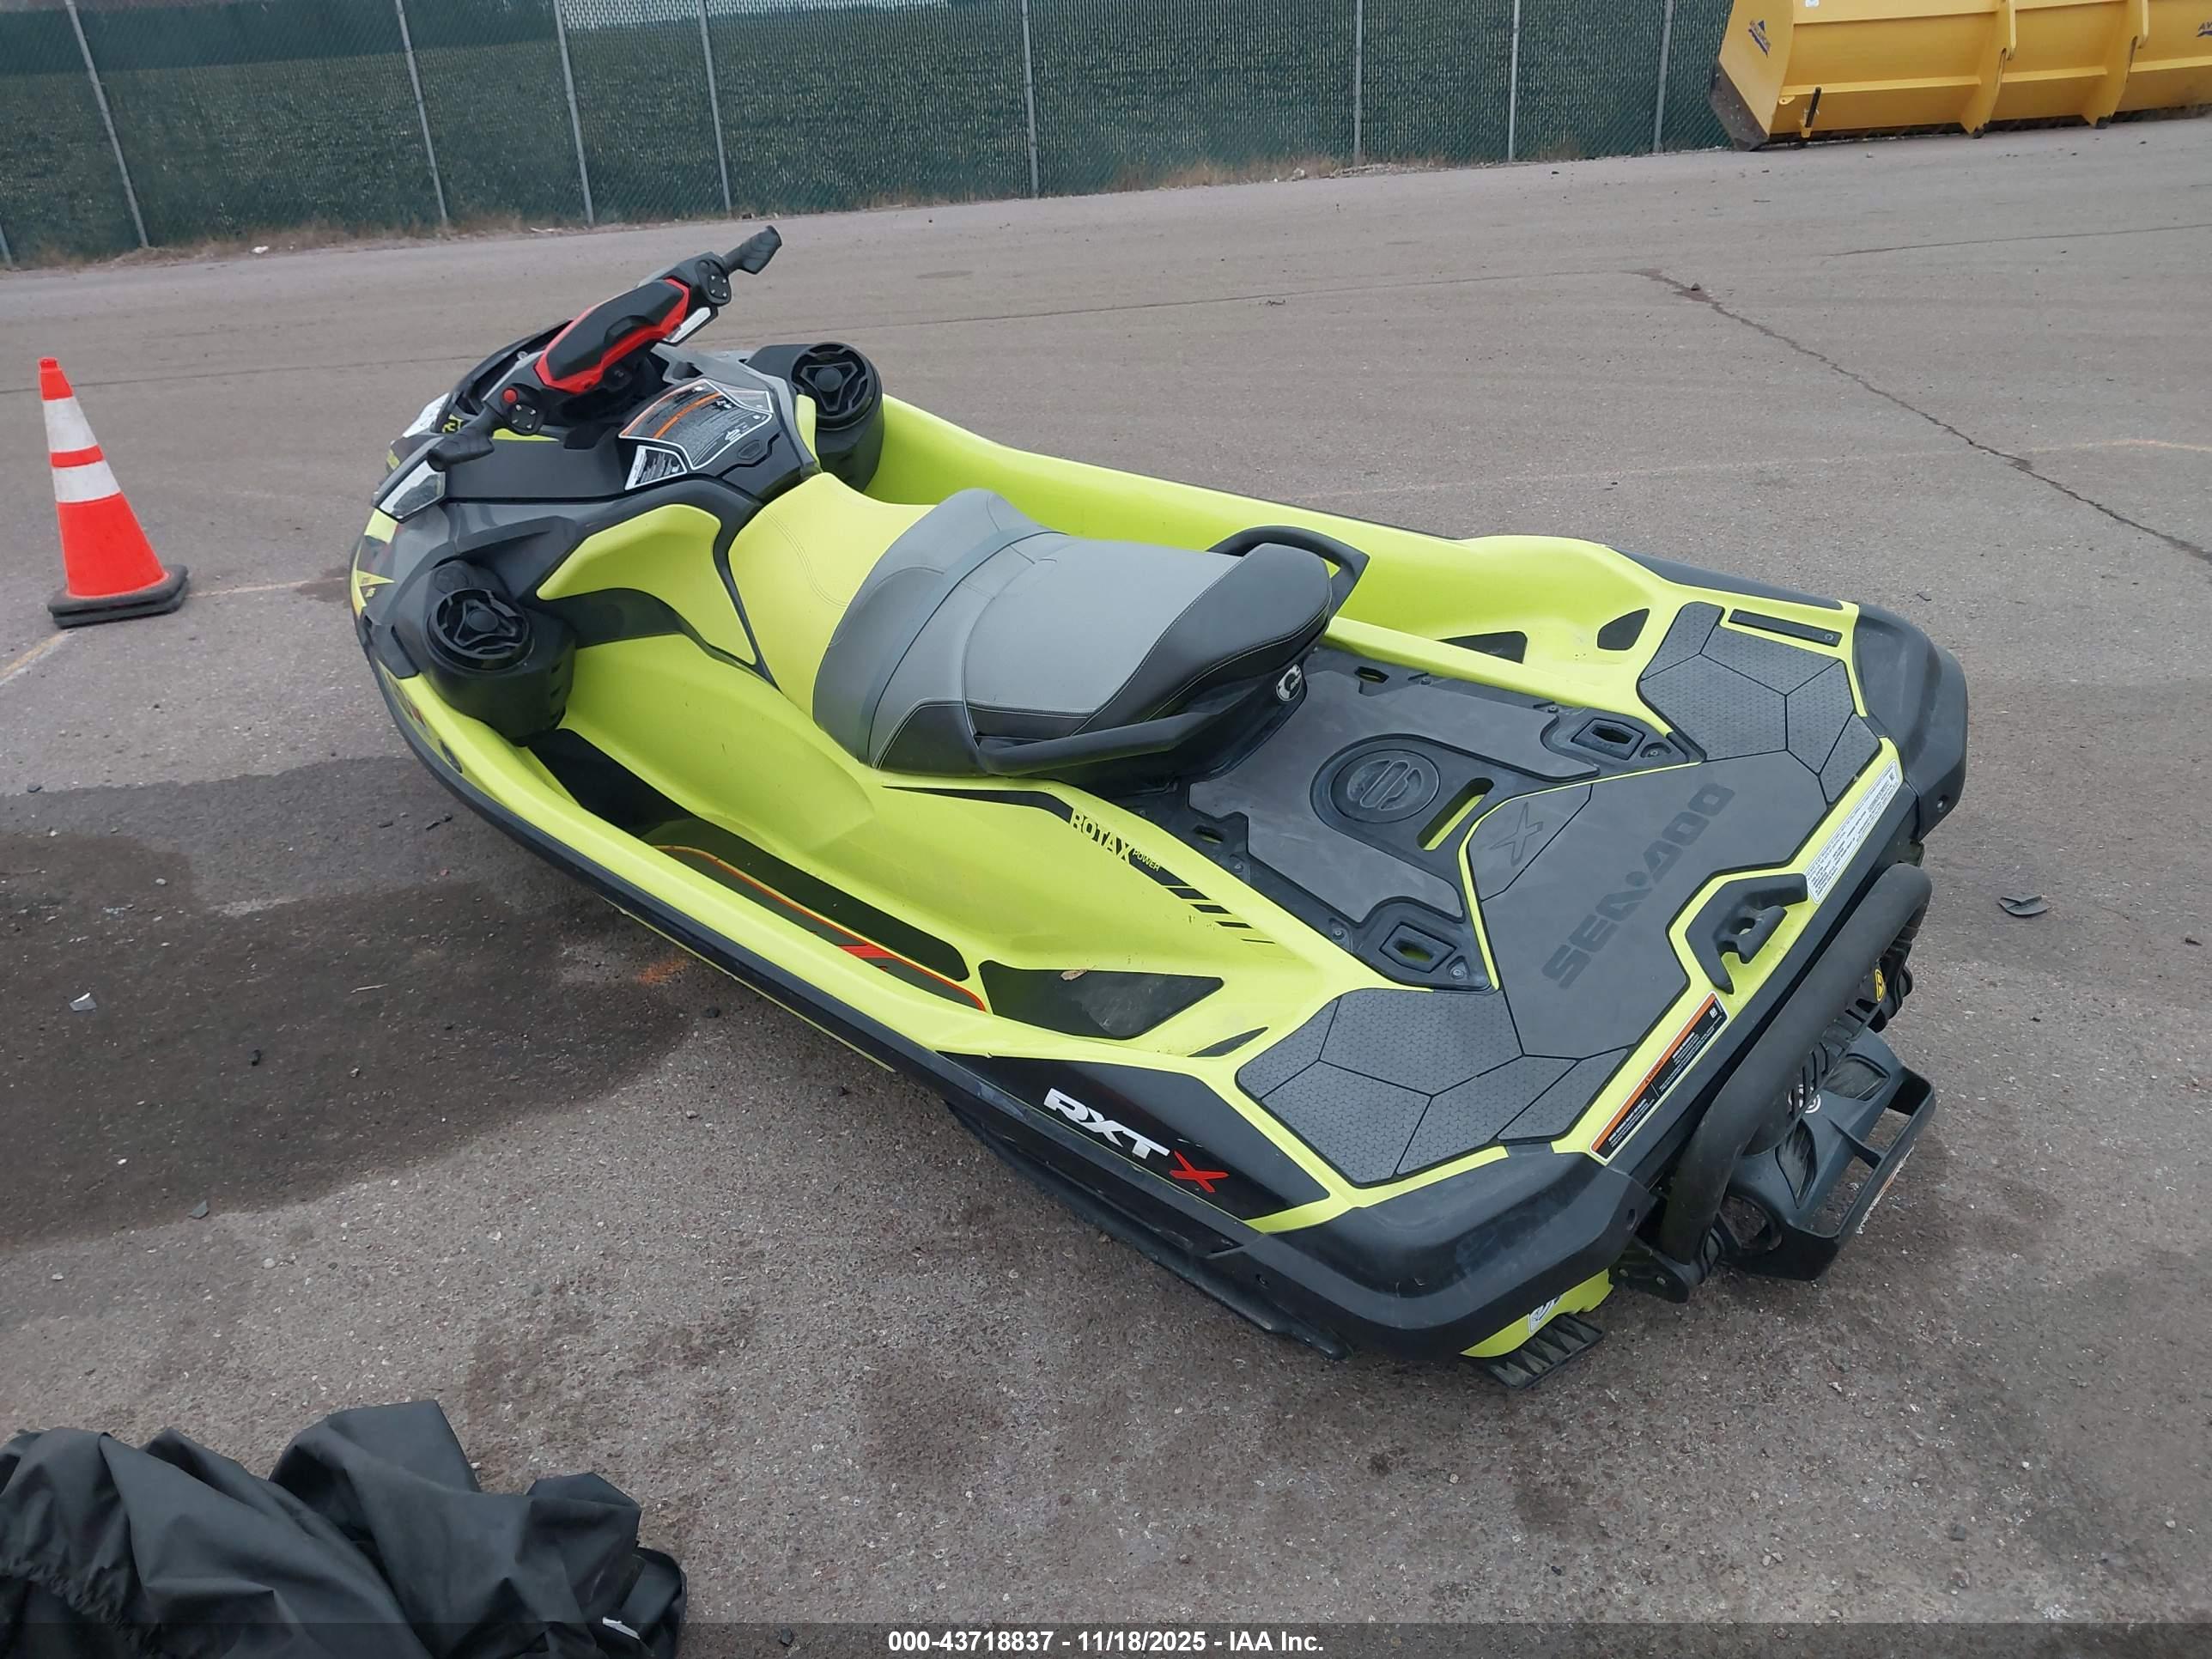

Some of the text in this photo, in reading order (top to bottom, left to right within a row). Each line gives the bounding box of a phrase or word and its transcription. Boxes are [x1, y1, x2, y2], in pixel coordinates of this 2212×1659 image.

[1071, 810, 1162, 872] ROTAX POWER
[1043, 1087, 1231, 1193] RXT X
